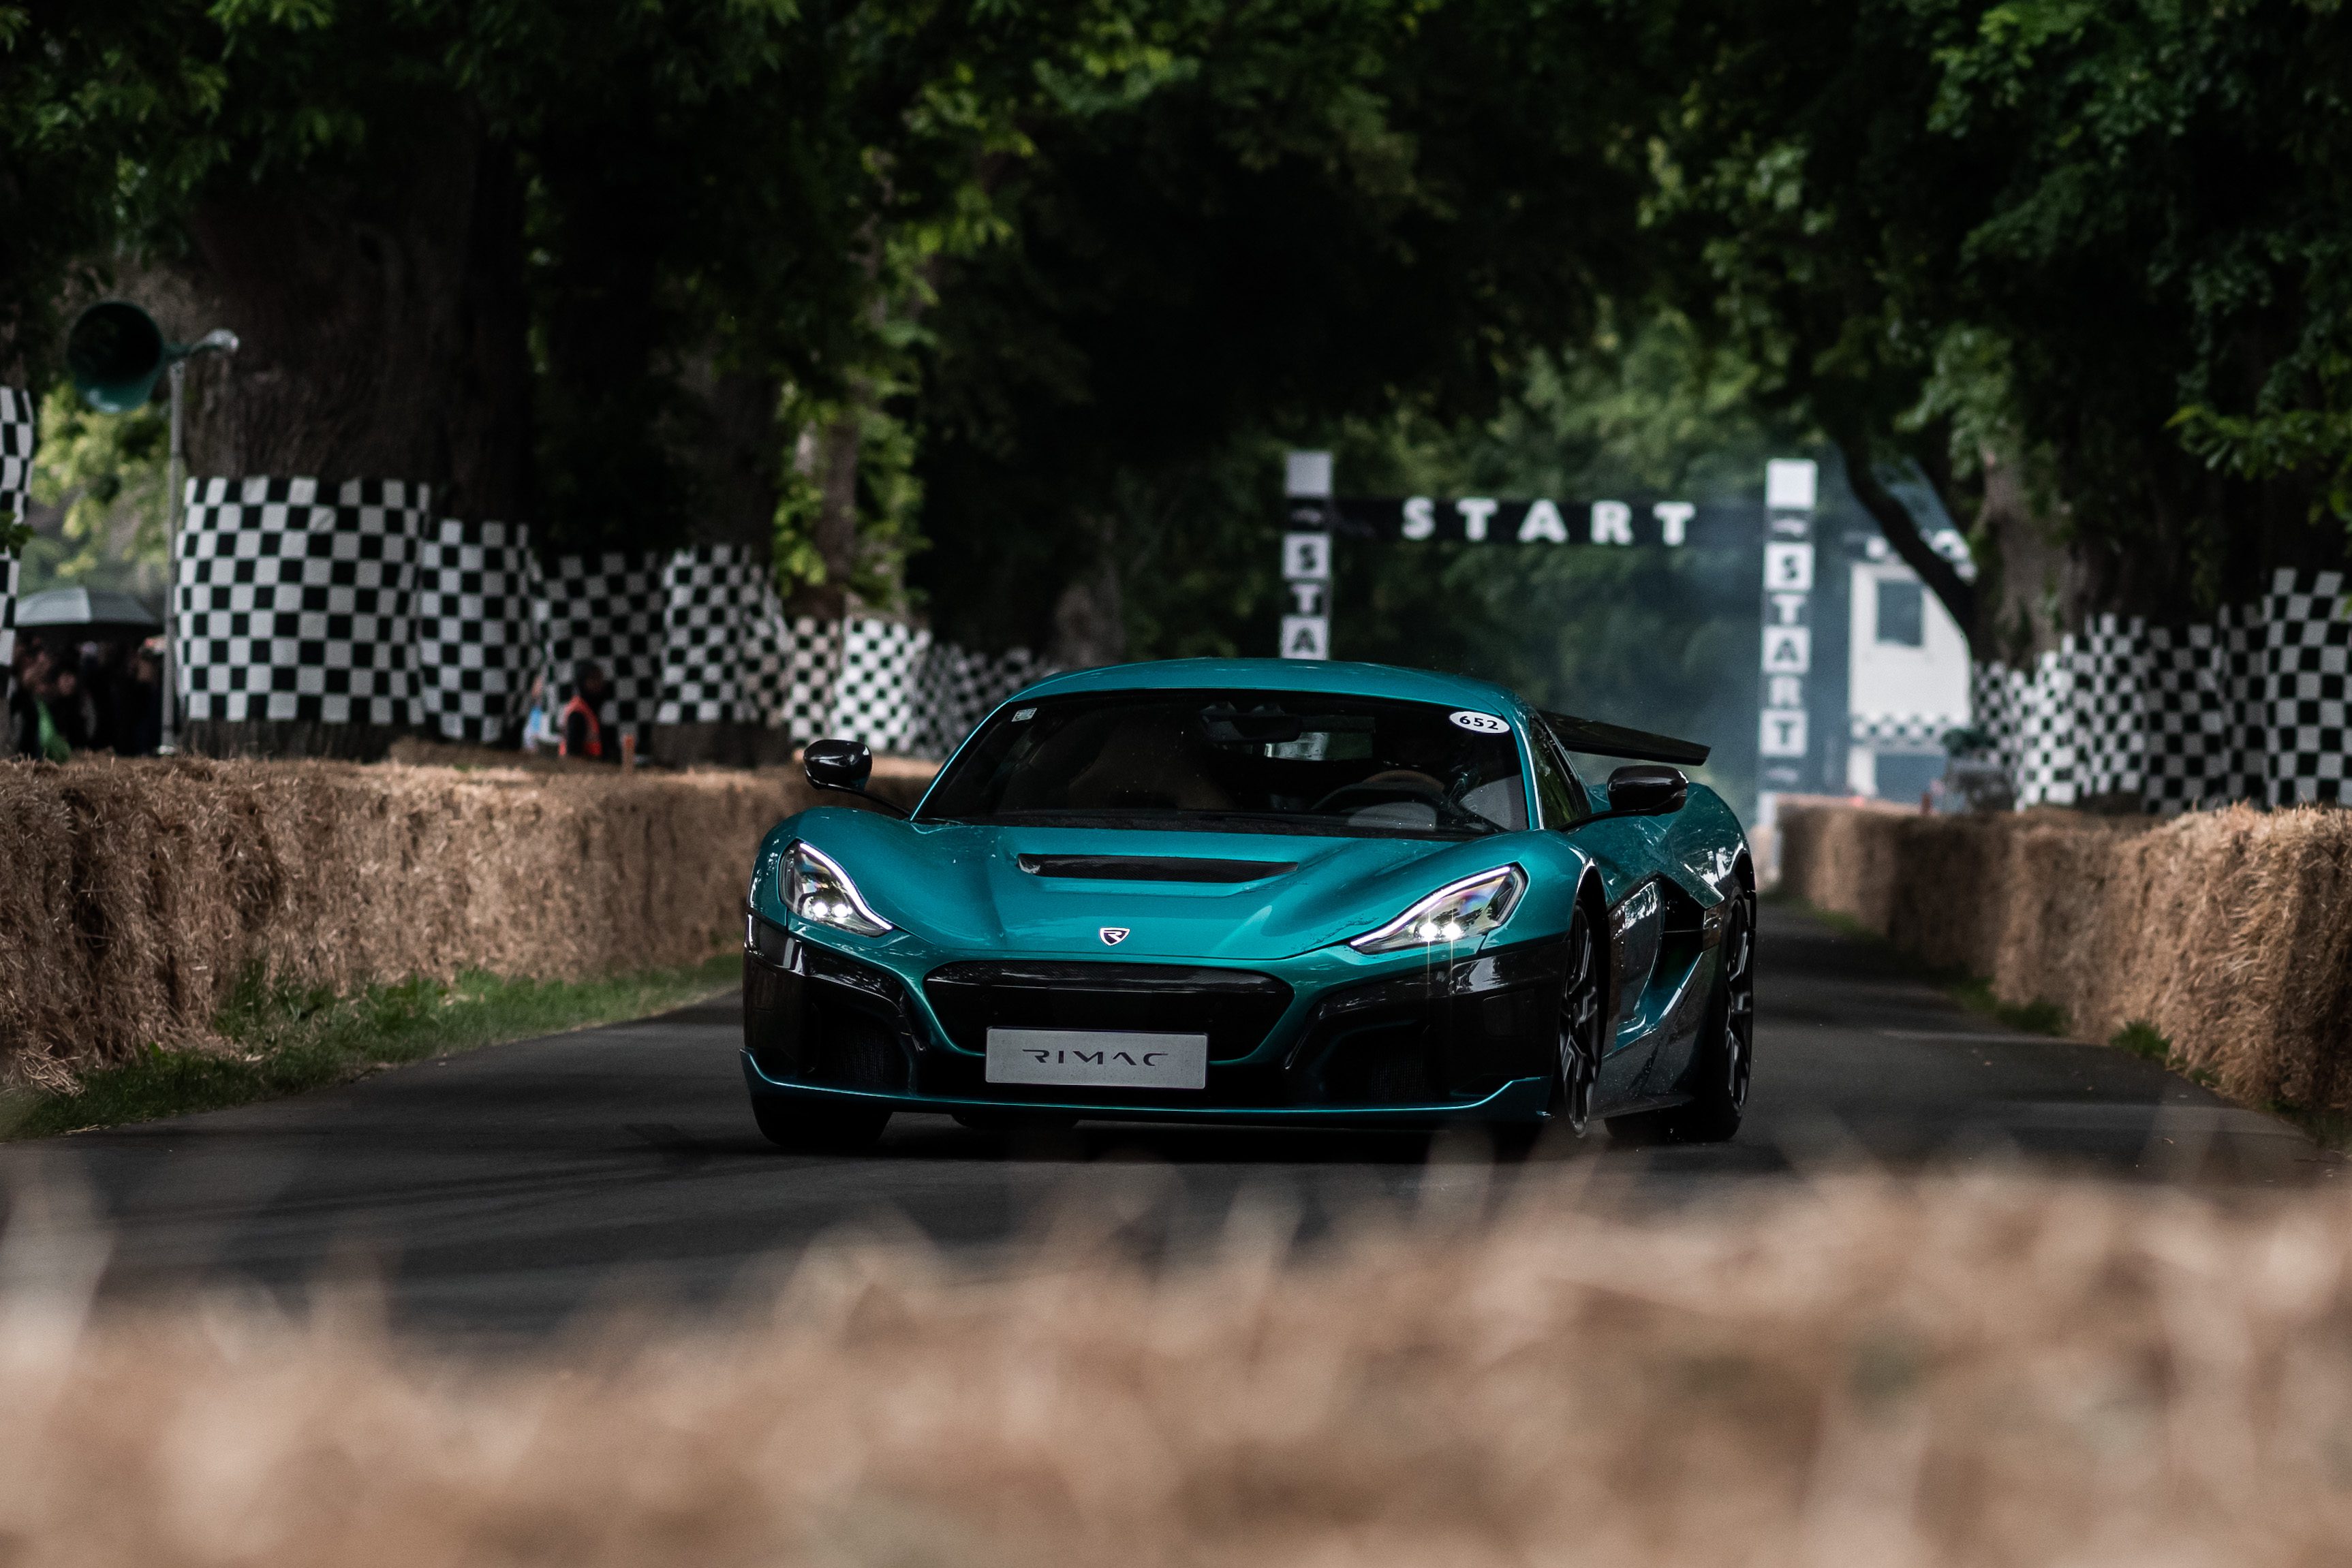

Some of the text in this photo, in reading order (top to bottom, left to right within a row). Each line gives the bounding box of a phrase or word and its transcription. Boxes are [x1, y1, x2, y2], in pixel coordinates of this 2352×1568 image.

[1401, 496, 1697, 546] START
[1771, 554, 1806, 747] START
[1459, 716, 1498, 730] 652
[1022, 1049, 1169, 1067] RIMAC
